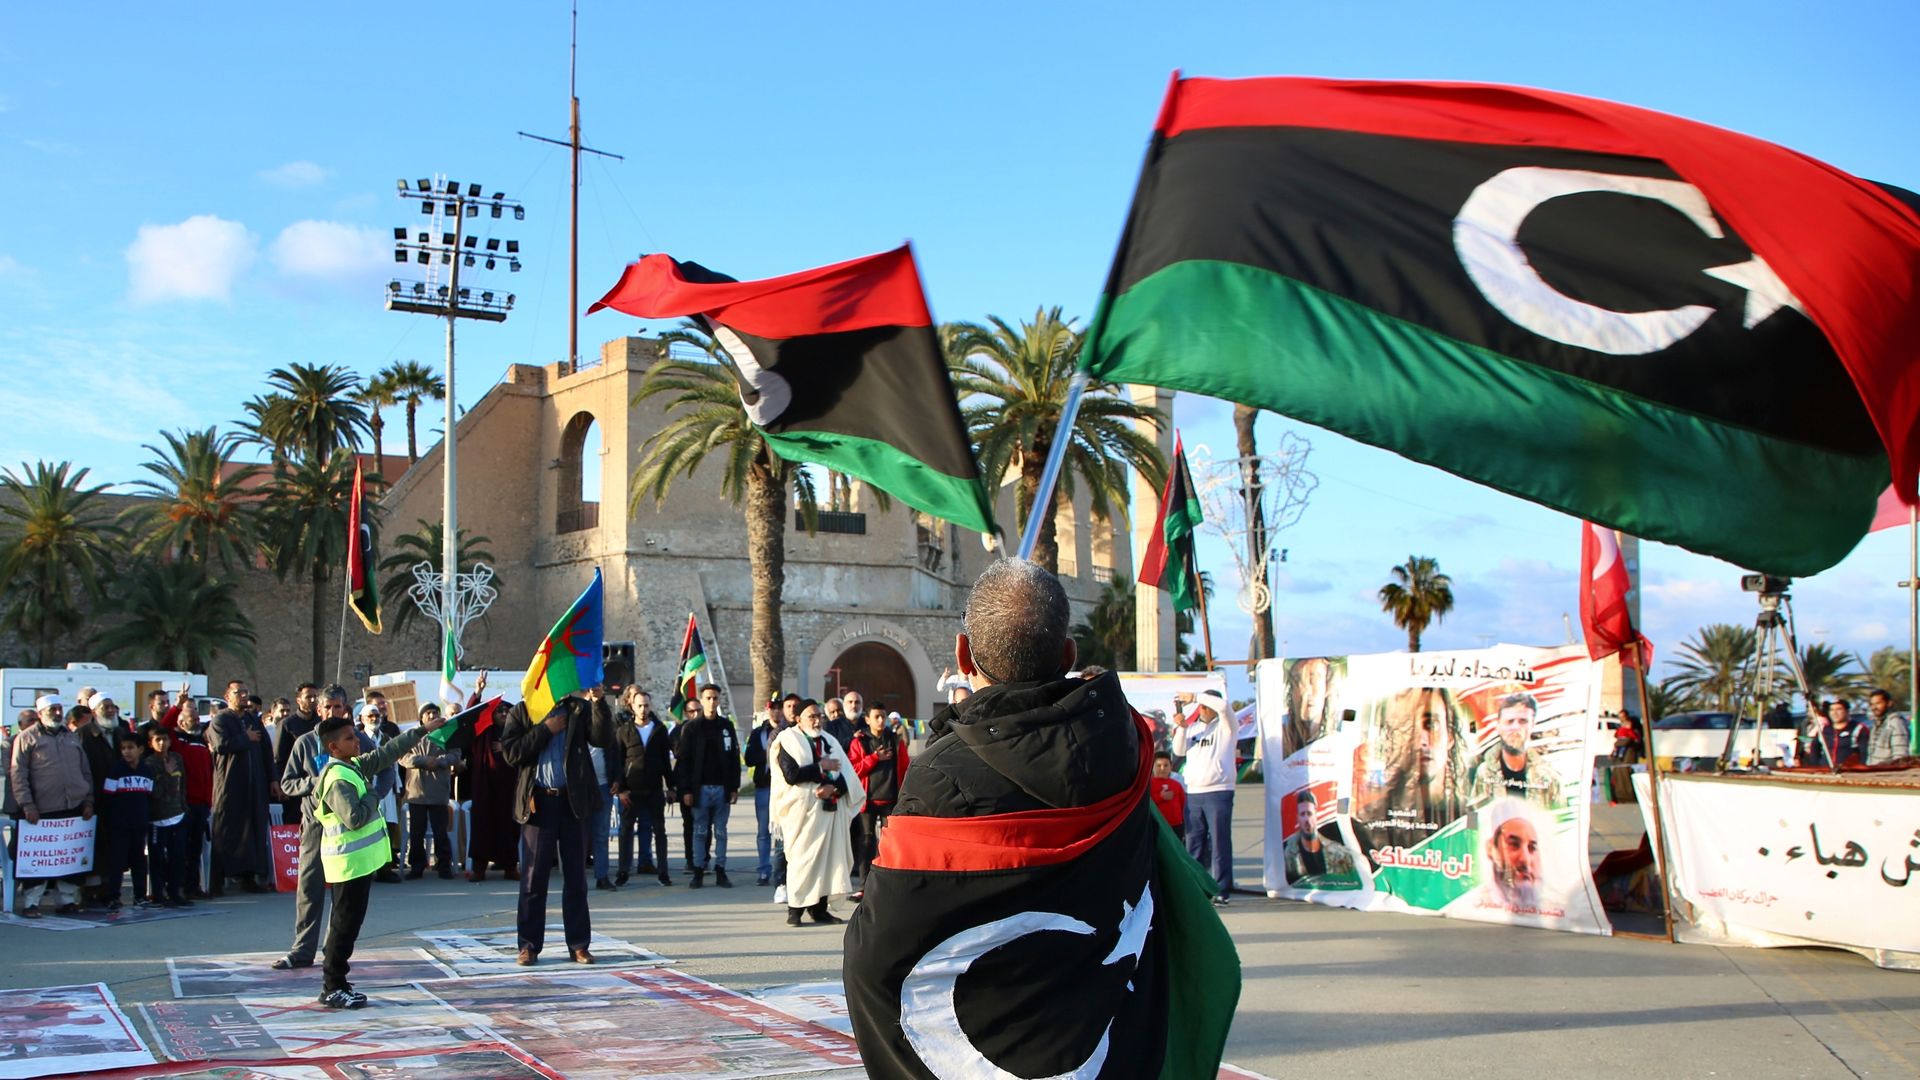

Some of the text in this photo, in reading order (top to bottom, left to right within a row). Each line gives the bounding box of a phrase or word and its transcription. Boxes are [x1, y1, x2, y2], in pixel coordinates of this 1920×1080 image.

[1410, 658, 1534, 682] شهداء ليبيا
[23, 834, 60, 843] SHARES
[33, 849, 68, 857] KILLING
[31, 856, 77, 867] CHILDREN
[1442, 856, 1472, 879] لن
